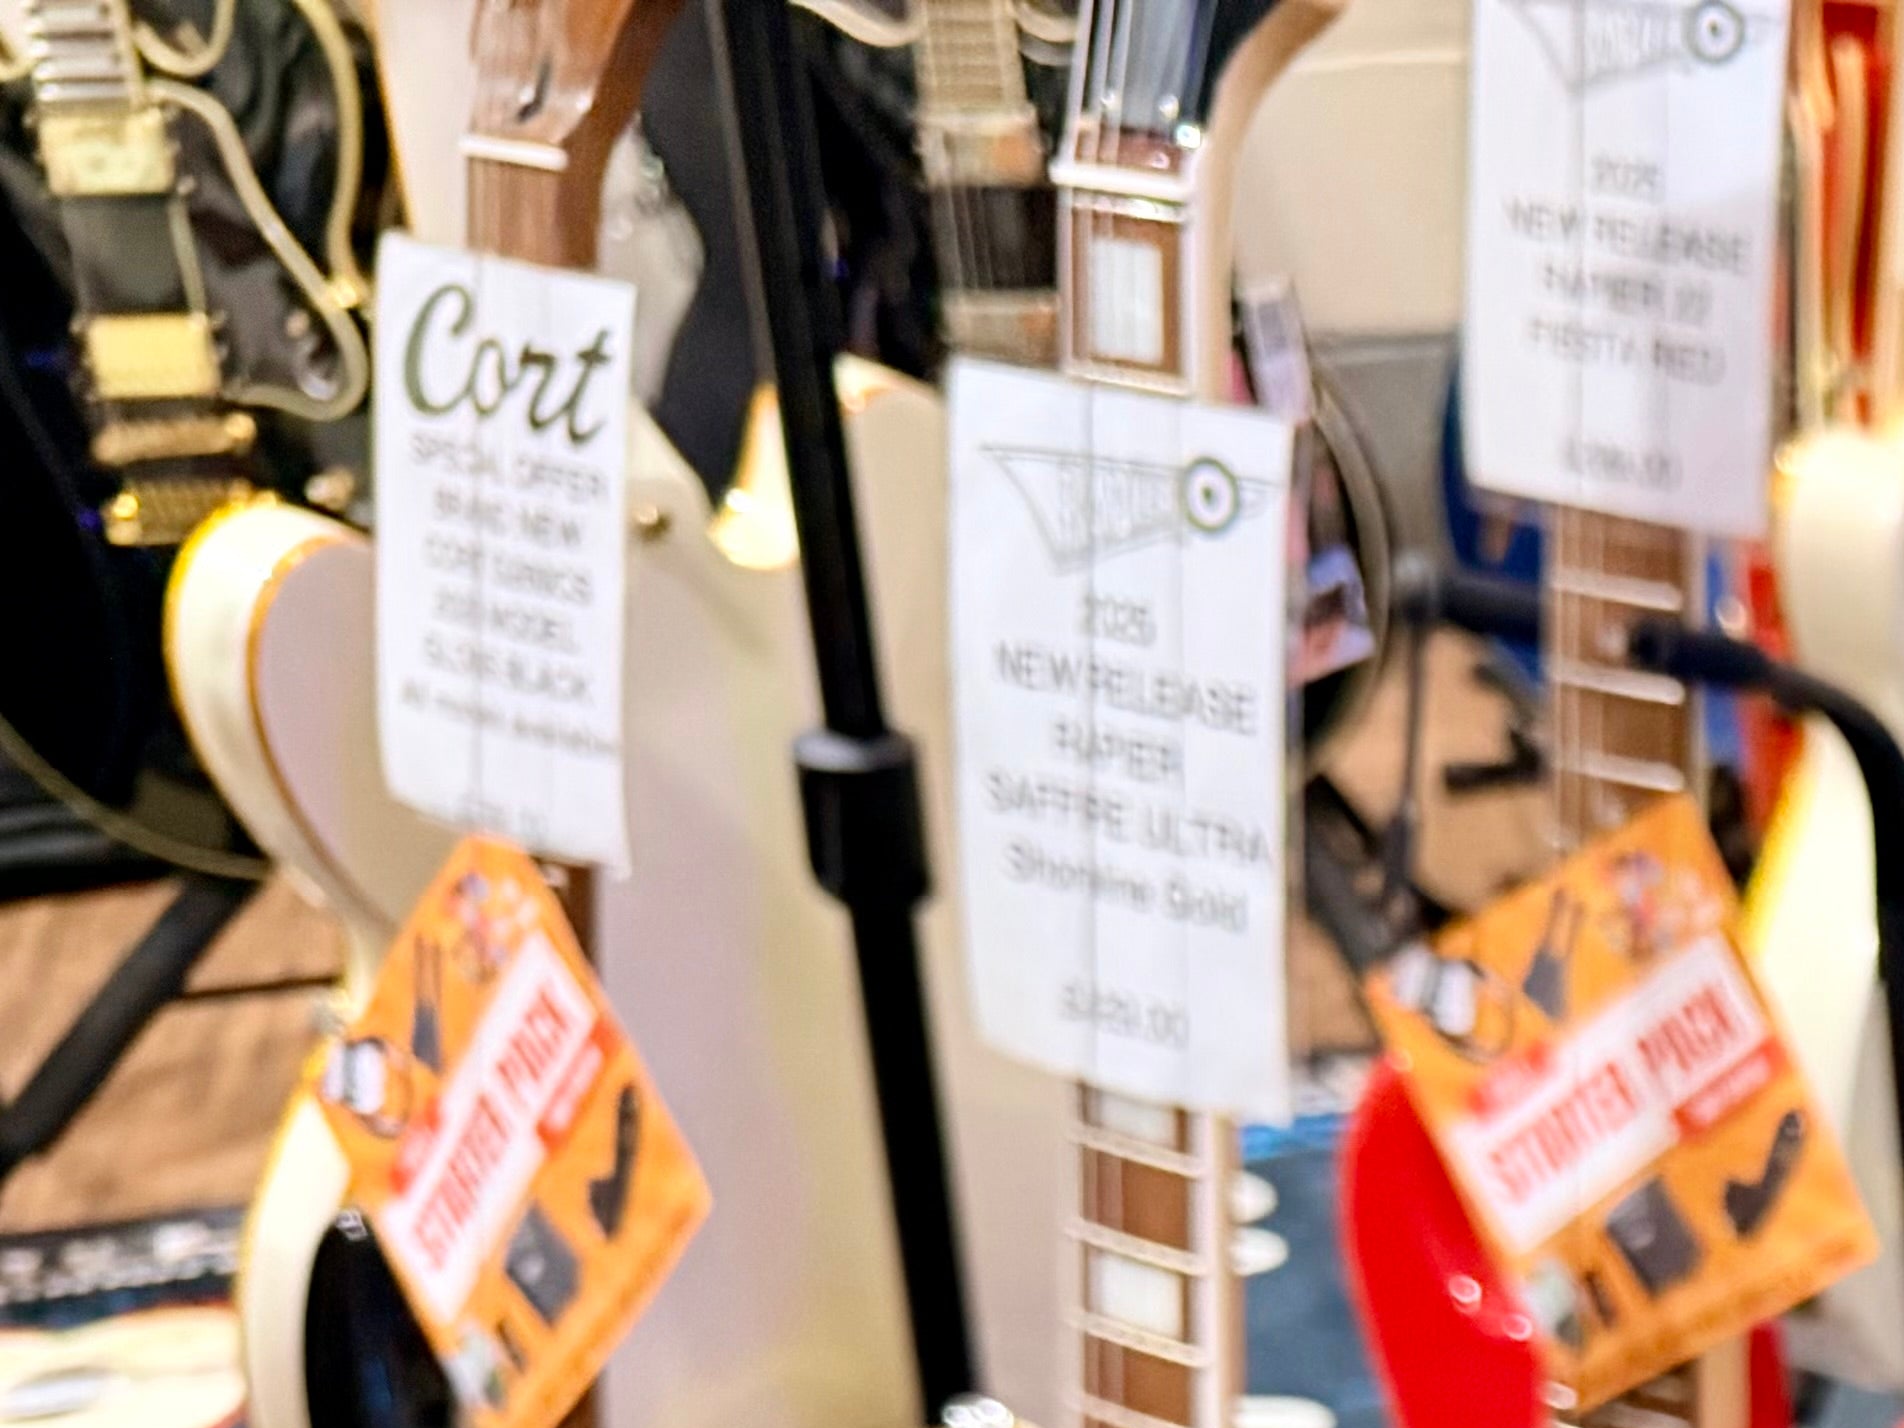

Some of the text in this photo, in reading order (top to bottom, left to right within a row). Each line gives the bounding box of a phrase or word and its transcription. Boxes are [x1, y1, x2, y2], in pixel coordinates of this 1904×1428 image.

[1504, 200, 1746, 272] NEW RELEASE
[404, 284, 613, 444] Cort
[1084, 597, 1153, 644] 2025
[995, 643, 1254, 733] NEW RELEASE
[1143, 809, 1271, 863] ULTRA
[1166, 872, 1245, 930] Gold
[414, 1097, 510, 1267] STARTER
[500, 994, 568, 1098] PACK
[1491, 1065, 1634, 1202] STARTER
[1639, 985, 1736, 1072] PACK
